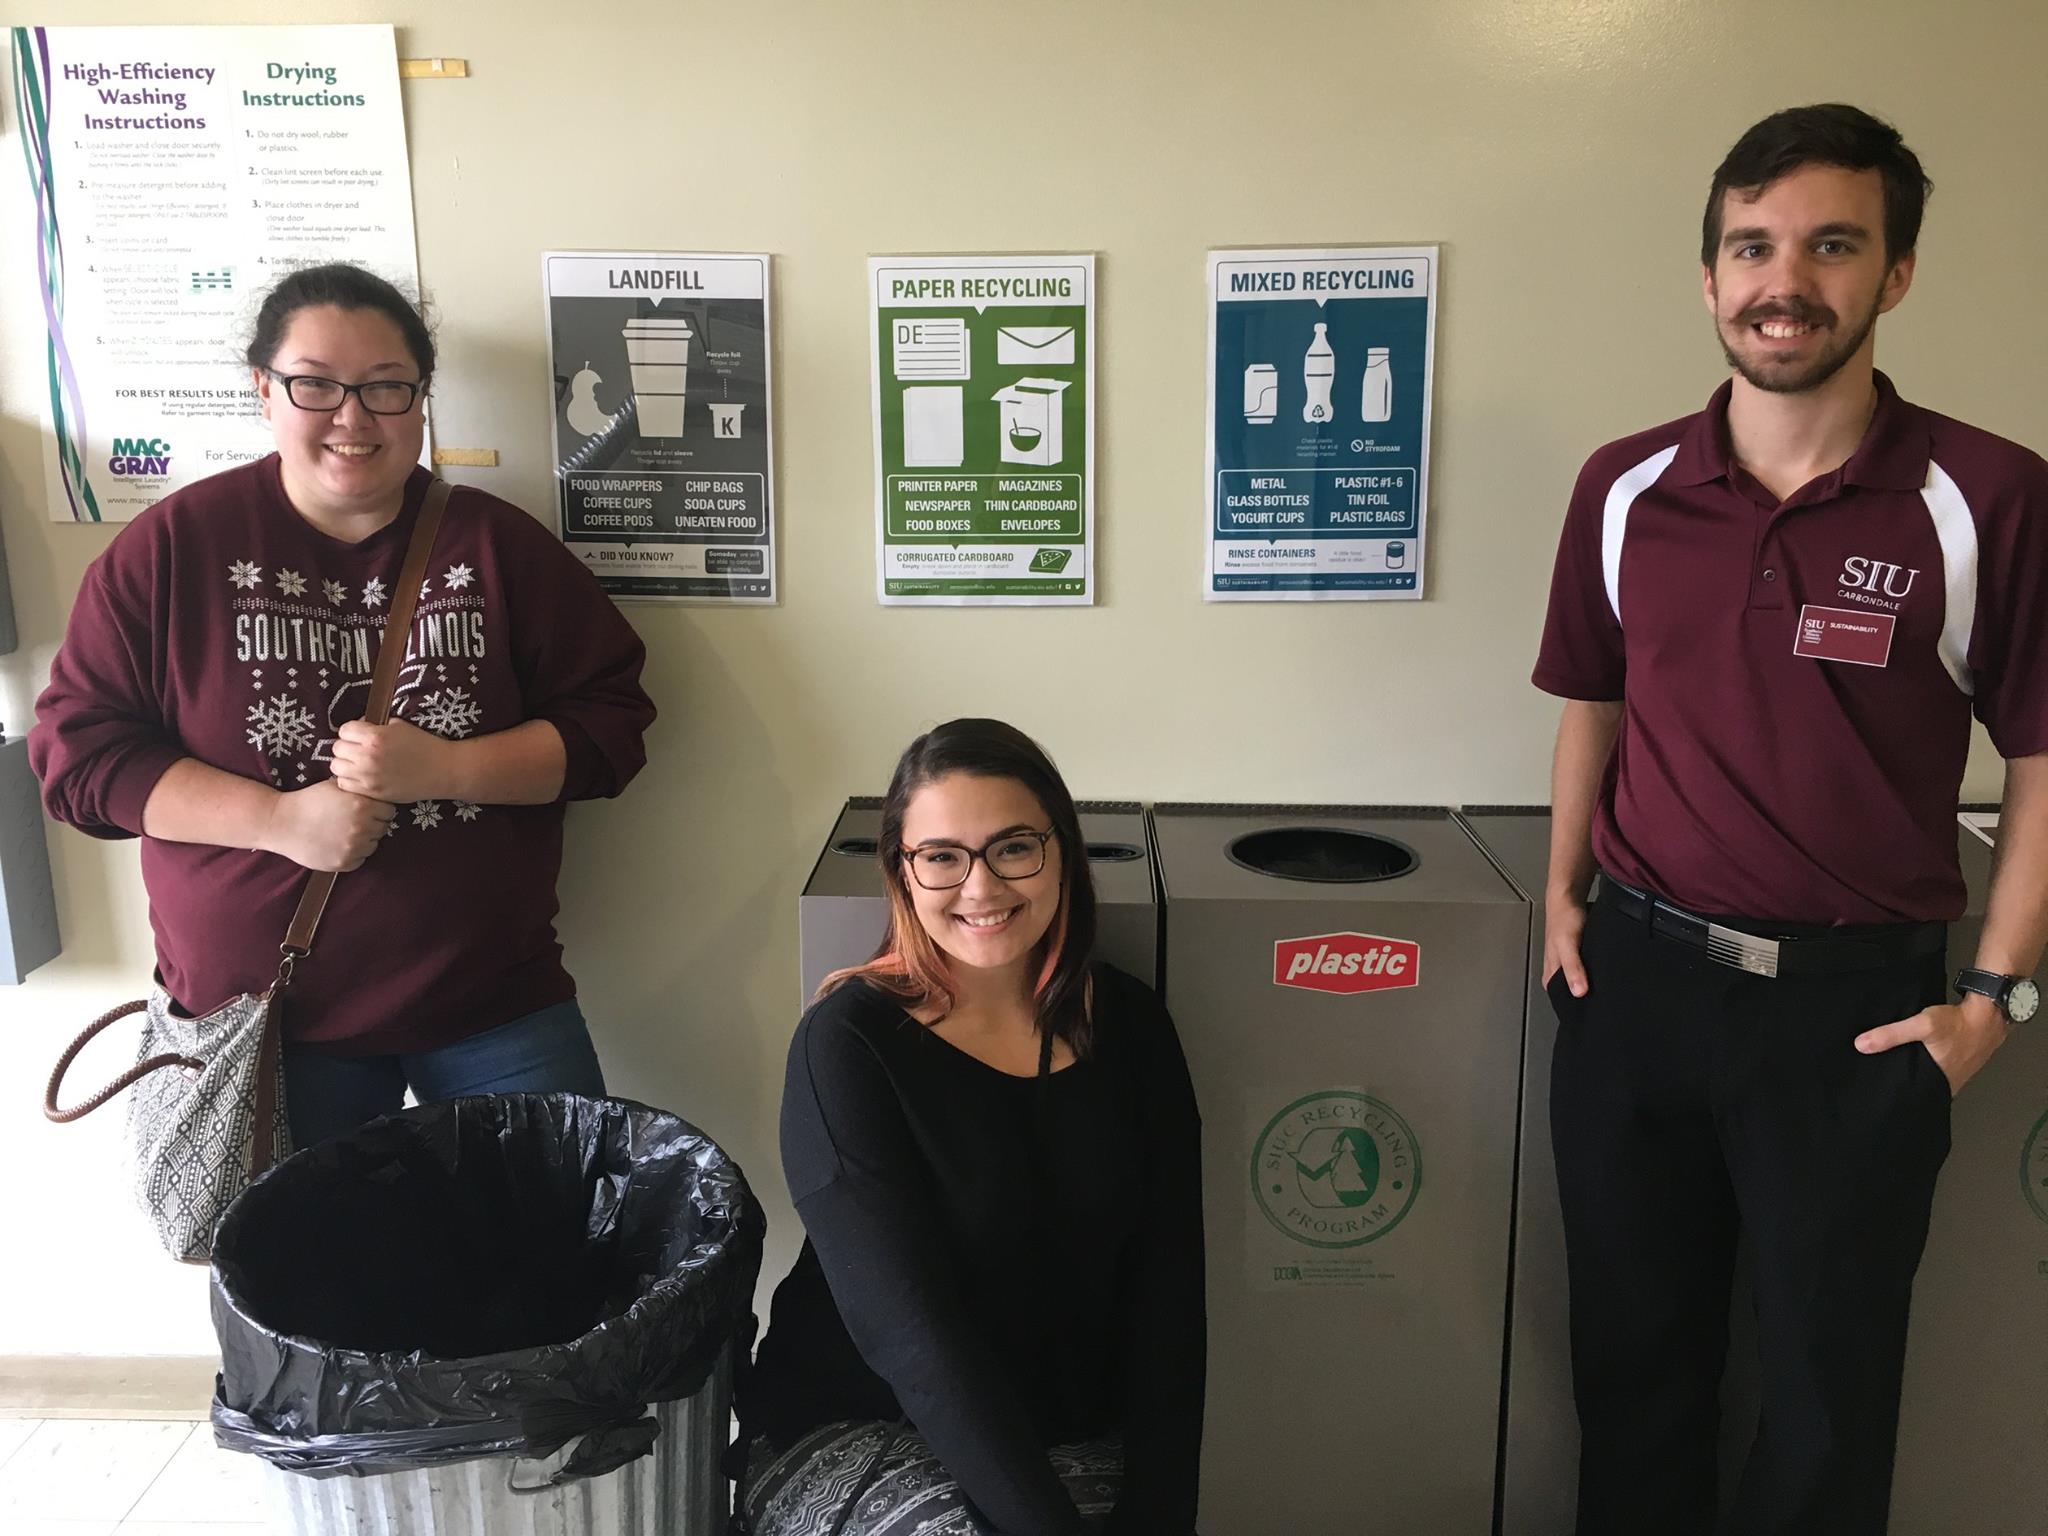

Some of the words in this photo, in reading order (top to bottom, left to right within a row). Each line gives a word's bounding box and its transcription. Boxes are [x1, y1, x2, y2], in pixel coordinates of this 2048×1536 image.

[63, 62, 216, 86] High-Efficiency
[266, 62, 337, 84] Drying
[98, 88, 187, 110] Washing
[242, 89, 366, 107] Instructions
[84, 113, 207, 130] Instructions
[245, 129, 254, 138] 1.
[257, 130, 270, 138] Do
[271, 130, 285, 138] not
[286, 130, 299, 140] dry
[300, 130, 322, 139] wool,
[322, 130, 349, 138] rubber
[74, 141, 83, 149] 1.
[134, 141, 149, 149] and
[151, 141, 169, 149] close
[171, 141, 190, 149] door
[248, 166, 258, 175] 2.
[260, 167, 283, 176] Clean
[284, 167, 297, 176] lint
[298, 168, 323, 176] screen
[324, 168, 349, 176] before
[350, 168, 368, 176] each
[77, 180, 88, 189] 2.
[138, 181, 173, 192] detergent
[174, 181, 199, 189] before
[201, 181, 227, 192] adding
[251, 199, 261, 208] 3.
[264, 200, 285, 209] Place
[286, 200, 313, 209] clothes
[314, 201, 322, 209] in
[323, 201, 343, 211] dryer
[345, 201, 360, 209] and
[265, 214, 285, 222] close
[257, 256, 267, 265] 4.
[608, 269, 704, 290] LANDFILL
[1231, 272, 1296, 292] MIXED
[1302, 269, 1414, 291] RECYCLING
[892, 279, 955, 298] PAPER
[961, 277, 1072, 298] RECYCLING
[897, 324, 923, 344] DE
[115, 389, 138, 399] FOR
[140, 389, 166, 399] BEST
[168, 389, 214, 399] RESULTS
[216, 389, 236, 399] USE
[185, 402, 207, 410] regular
[187, 410, 211, 418] garment
[212, 410, 226, 418] tags
[721, 416, 735, 436] K
[205, 450, 224, 461] For
[226, 450, 264, 461] Service
[108, 456, 171, 475] GRAY
[113, 476, 142, 484] Intelligent
[571, 479, 599, 492] FOOD
[602, 480, 663, 492] WRAPPERS
[898, 480, 942, 492] PRINTER
[944, 480, 978, 492] PAPER
[998, 480, 1063, 491] MAGAZINES
[1251, 478, 1287, 489] METAL
[1335, 477, 1379, 488] PLASTIC
[1380, 476, 1404, 488] #1-6
[134, 483, 161, 491] Systems
[685, 481, 711, 493] CHIP
[713, 481, 744, 493] BAGS
[583, 496, 621, 509] COFFEE
[623, 497, 652, 510] CUPS
[684, 498, 715, 511] SODA
[717, 499, 747, 511] CUPS
[905, 500, 971, 511] NEWSPAPER
[984, 500, 1009, 511] THIN
[1011, 500, 1078, 511] CARDBOARD
[1227, 496, 1262, 507] GLASS
[1264, 495, 1310, 506] BOTTLES
[1347, 494, 1366, 505] TIN
[1368, 494, 1390, 505] FOIL
[583, 515, 622, 527] COFFEE
[624, 515, 653, 527] PODS
[675, 516, 726, 528] UNEATEN
[727, 517, 757, 529] FOOD
[1231, 512, 1274, 524] YOGURT
[1277, 512, 1305, 524] CUPS
[1330, 511, 1374, 523] PLASTIC
[1375, 511, 1406, 522] BAGS
[906, 520, 934, 531] FOOD
[936, 519, 971, 531] BOXES
[1000, 519, 1061, 531] ENVELOPES
[600, 551, 616, 561] DID
[618, 551, 638, 561] YOU
[640, 552, 674, 562] KNOW?
[896, 552, 956, 563] CORRUGATED
[958, 552, 1014, 563] CARDBOARD
[1228, 549, 1256, 559] RINSE
[1258, 548, 1316, 559] CONTAINERS
[1216, 578, 1231, 586] SIU
[1838, 555, 1920, 598] SIU
[888, 582, 903, 591] SIU
[1837, 589, 1901, 611] CARBONDALE
[1804, 618, 1826, 630] SIU
[1829, 622, 1879, 634] SUSTAINABILITY
[236, 613, 371, 675] SOUTHERN
[1286, 944, 1408, 980] plastic
[1266, 1126, 1296, 1171] SIUC
[1300, 1105, 1408, 1169] RECYCLING
[1287, 1202, 1389, 1235] PROGRAM
